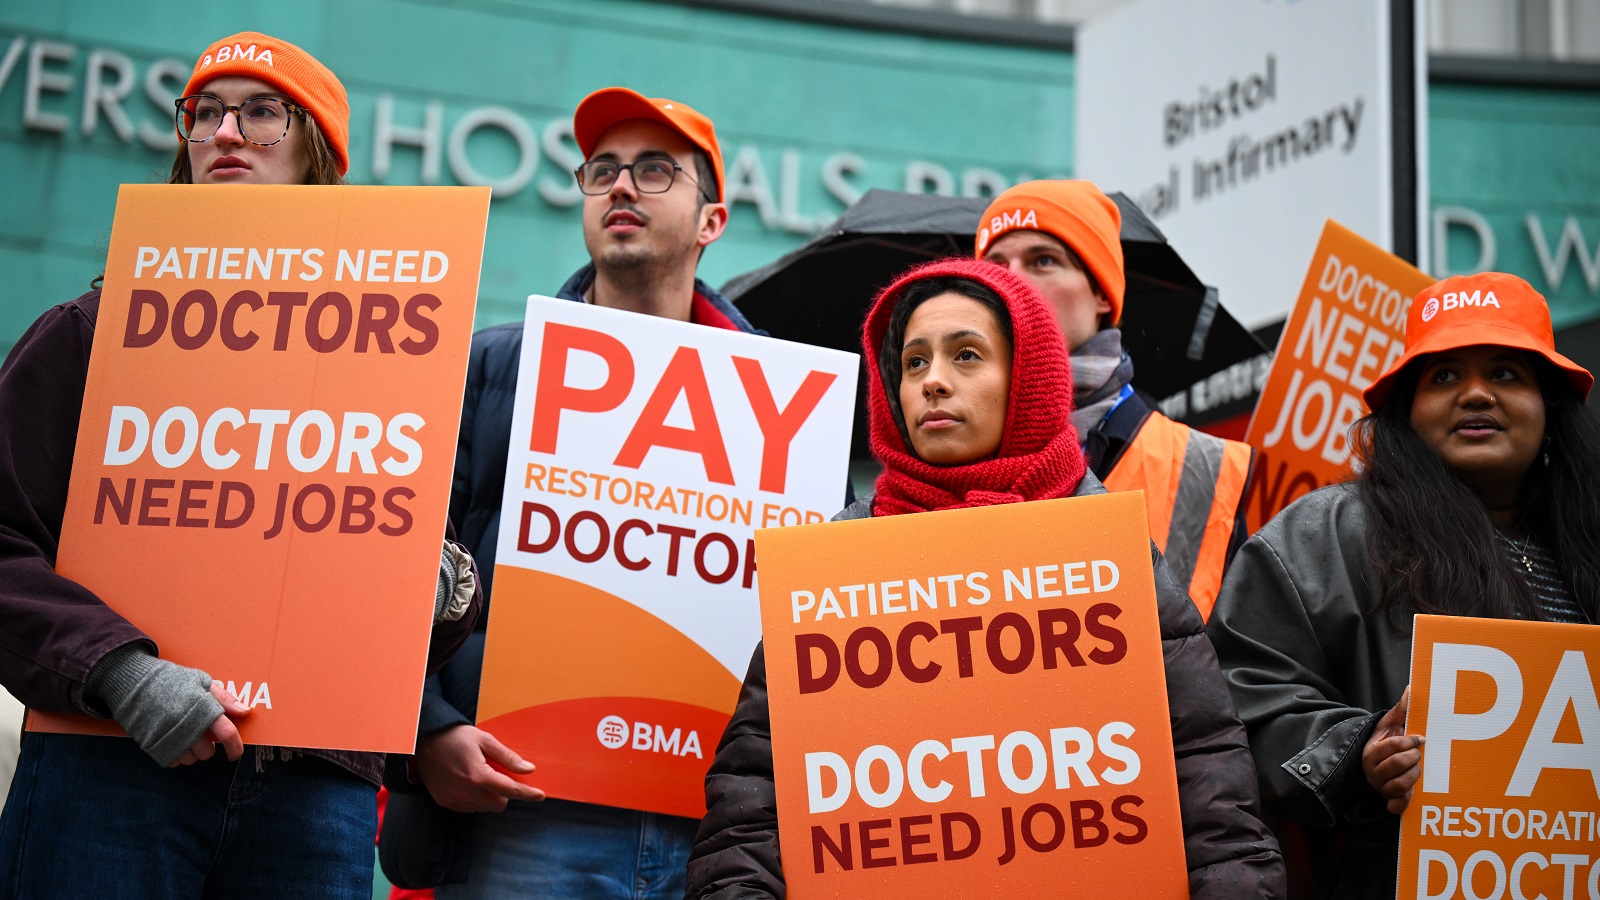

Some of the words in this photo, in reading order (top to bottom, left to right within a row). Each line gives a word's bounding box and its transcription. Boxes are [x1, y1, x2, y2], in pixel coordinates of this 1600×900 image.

[215, 43, 274, 67] BMA
[1163, 51, 1276, 147] Bristol
[1192, 97, 1366, 204] Infirmary
[991, 208, 1039, 235] BMA
[134, 246, 324, 282] PATIENTS
[335, 248, 449, 284] NEED
[1318, 253, 1413, 337] DOCTOR
[122, 289, 443, 356] DOCTORS
[1443, 289, 1501, 312] BMA
[102, 405, 427, 476] DOCTORS
[529, 321, 839, 495] PAY
[93, 477, 255, 529] NEED
[263, 482, 417, 540] JOBS
[524, 462, 753, 527] RESTORATION
[517, 501, 758, 589] DOCTO
[790, 571, 992, 624] PATIENTS
[1003, 559, 1120, 602] NEED
[794, 602, 1128, 694] DOCTORS
[631, 721, 703, 760] BMA
[805, 721, 1141, 814] DOCTORS
[810, 811, 982, 875] NEED
[997, 794, 1149, 866] JOBS
[1420, 805, 1600, 842] RESTORATI
[1416, 848, 1600, 900] DOCT
